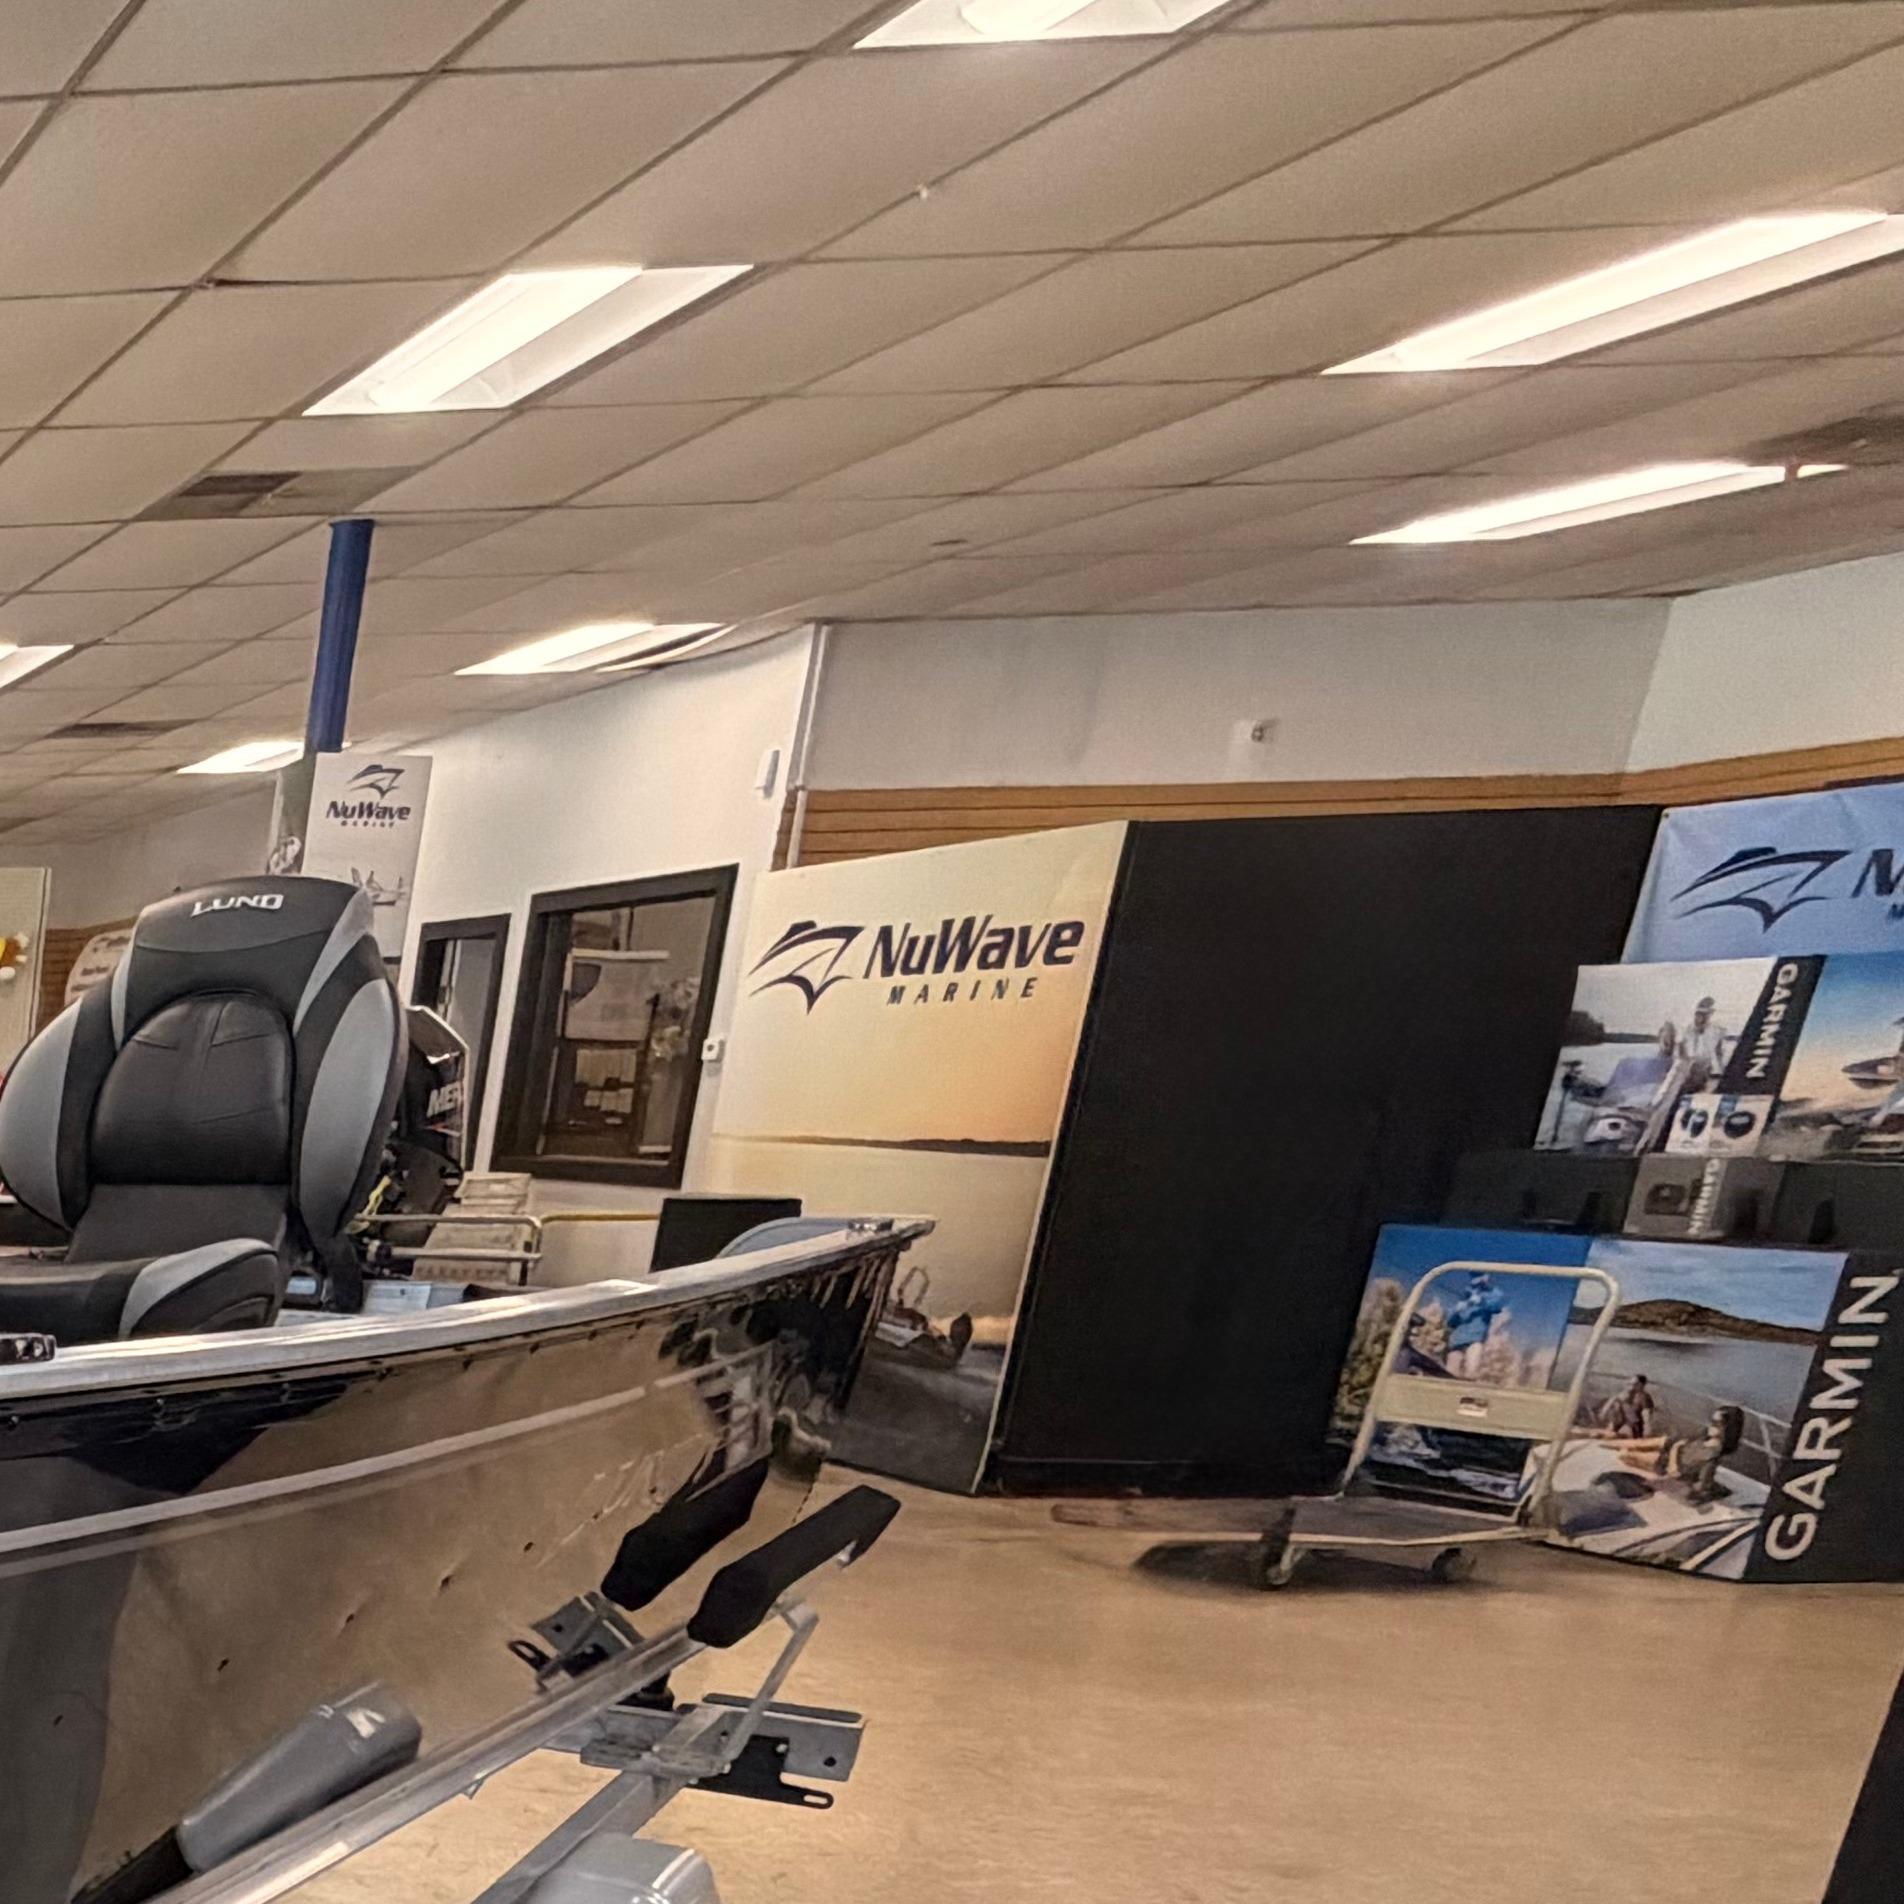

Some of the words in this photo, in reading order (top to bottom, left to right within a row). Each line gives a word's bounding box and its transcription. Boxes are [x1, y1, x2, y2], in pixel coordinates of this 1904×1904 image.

[326, 800, 411, 820] NuWave
[190, 894, 284, 918] LUND
[863, 914, 1085, 980] NuWave
[886, 976, 1038, 1006] MARINE
[1745, 963, 1799, 1080] GARMIN
[1764, 1275, 1900, 1561] GARMIN
